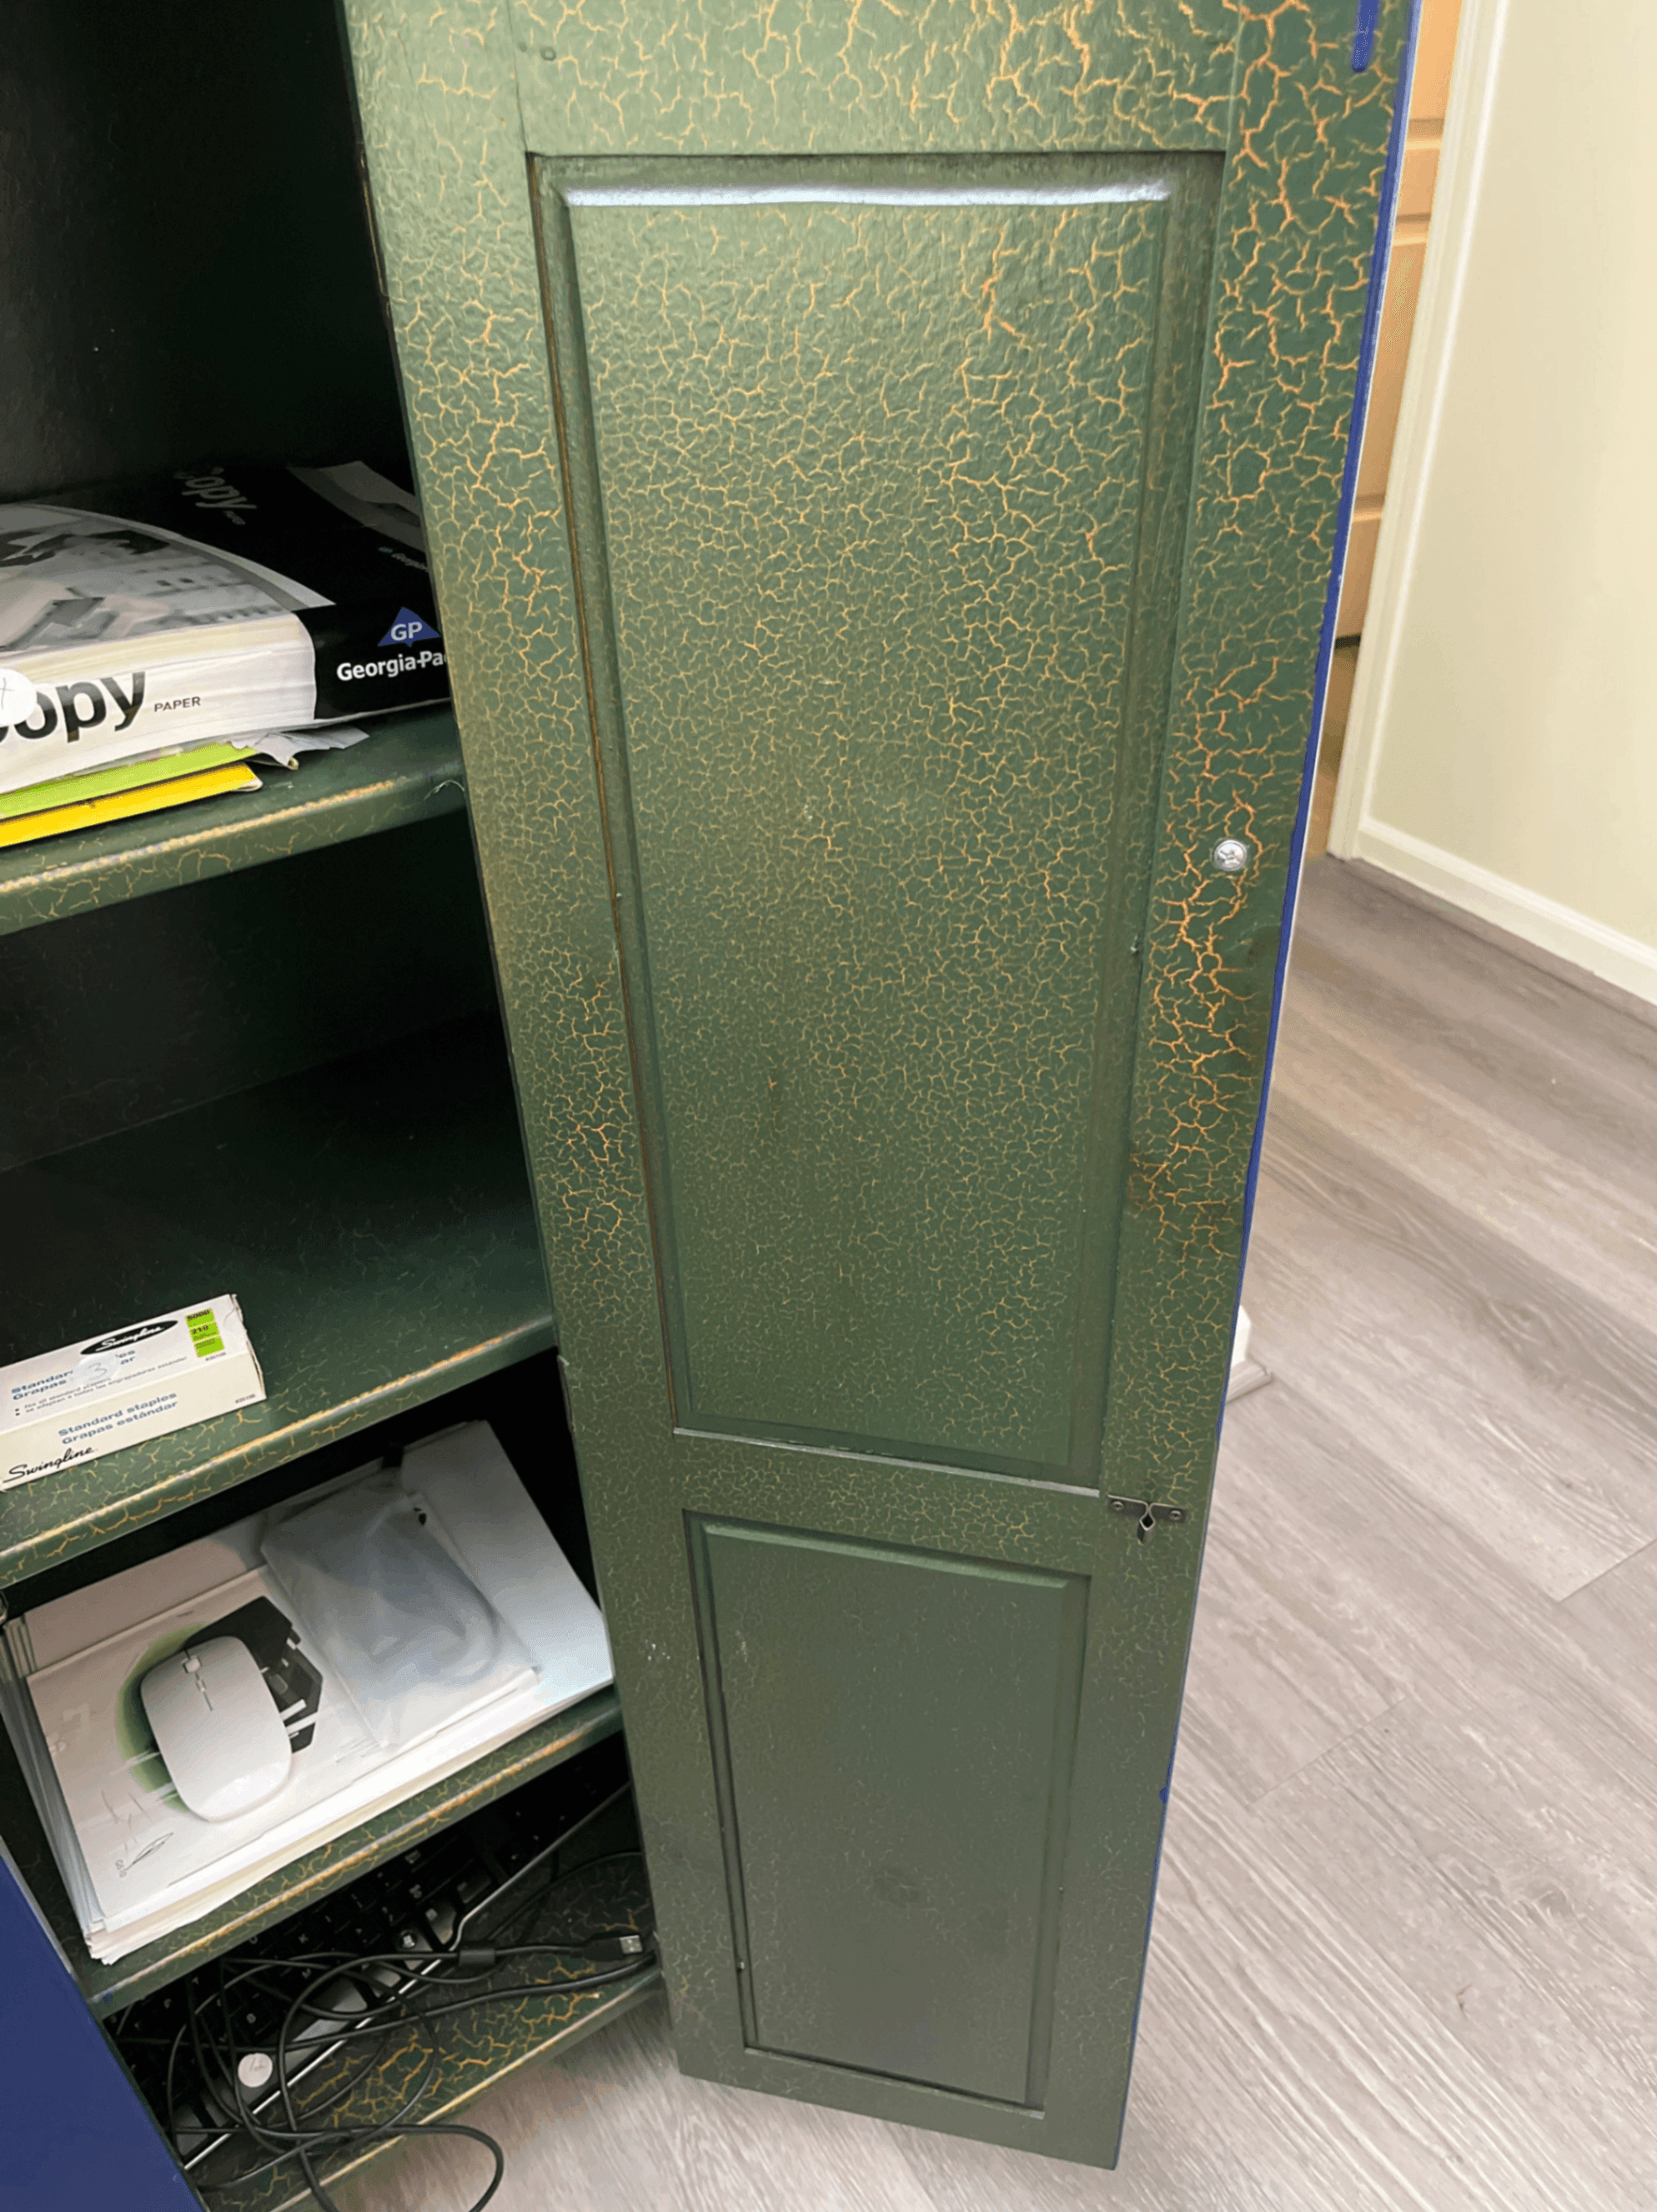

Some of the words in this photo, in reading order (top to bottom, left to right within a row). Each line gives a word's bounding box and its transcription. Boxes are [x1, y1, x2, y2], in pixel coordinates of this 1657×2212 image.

[390, 621, 423, 641] GP
[336, 651, 448, 681] Georgia-Pa
[0, 671, 146, 743] opy
[153, 696, 201, 713] PAPER
[95, 1326, 163, 1352] Swingline
[11, 1370, 73, 1394] Standar
[13, 1379, 68, 1400] Grapas
[58, 1410, 124, 1437] Standard
[126, 1392, 178, 1414] staples
[61, 1423, 114, 1445] Grapas
[116, 1400, 178, 1427] estándar
[2, 1446, 96, 1485] Swingline
